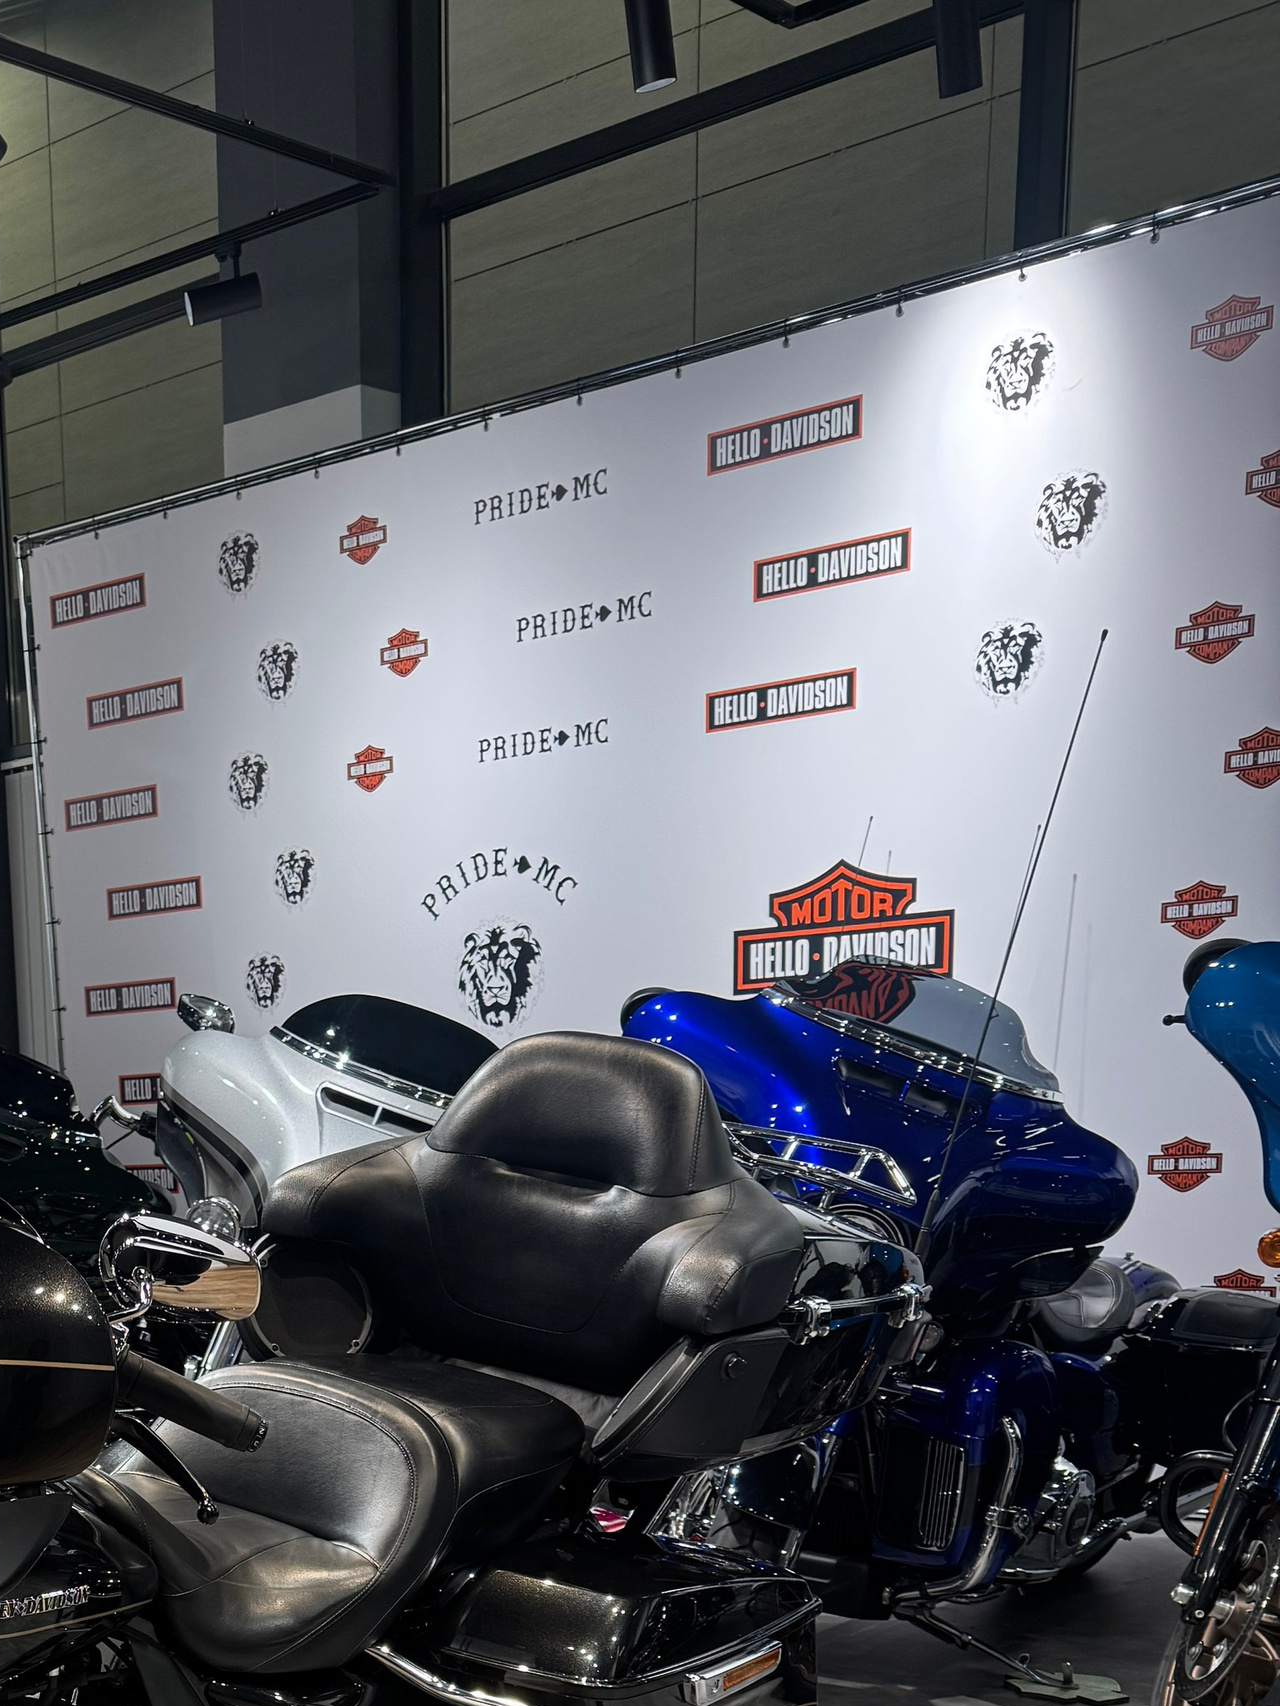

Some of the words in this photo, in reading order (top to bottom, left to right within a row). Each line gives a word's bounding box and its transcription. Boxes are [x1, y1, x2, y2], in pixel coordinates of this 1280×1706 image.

[716, 428, 761, 467] HELLO
[770, 404, 854, 454] DAVIDSON
[474, 481, 550, 525] PRIDE
[572, 467, 608, 502] MC
[762, 556, 808, 594] HELLO
[817, 536, 903, 583] DAVIDSON
[55, 594, 84, 623] HELLO
[89, 580, 141, 615] DAVIDSON
[516, 602, 593, 643] PRIDE
[616, 590, 652, 623] MC
[1197, 607, 1234, 624] MOTOR
[1181, 628, 1204, 644] HELLO
[1208, 620, 1249, 640] DAVIDSON
[92, 696, 120, 724] HELLO
[126, 683, 178, 717] DAVIDSON
[713, 691, 758, 726] HELLO
[766, 676, 848, 717] DAVIDSON
[478, 726, 552, 763] PRIDE
[574, 718, 609, 747] MC
[69, 800, 98, 826] HELLO
[102, 790, 153, 821] DAVIDSON
[111, 890, 140, 915] HELLO
[145, 881, 197, 910] DAVIDSON
[420, 847, 508, 921] PRIDE
[532, 856, 578, 906] MC
[791, 879, 893, 926] MOTOR
[1182, 886, 1218, 901] MOTOR
[749, 938, 810, 980] HELLO
[89, 988, 117, 1012] HELLO
[122, 982, 171, 1009] DAVIDSON
[124, 1078, 152, 1101] HELLO
[1168, 1141, 1203, 1155] MOTOR
[1221, 1274, 1257, 1287] MOTOR
